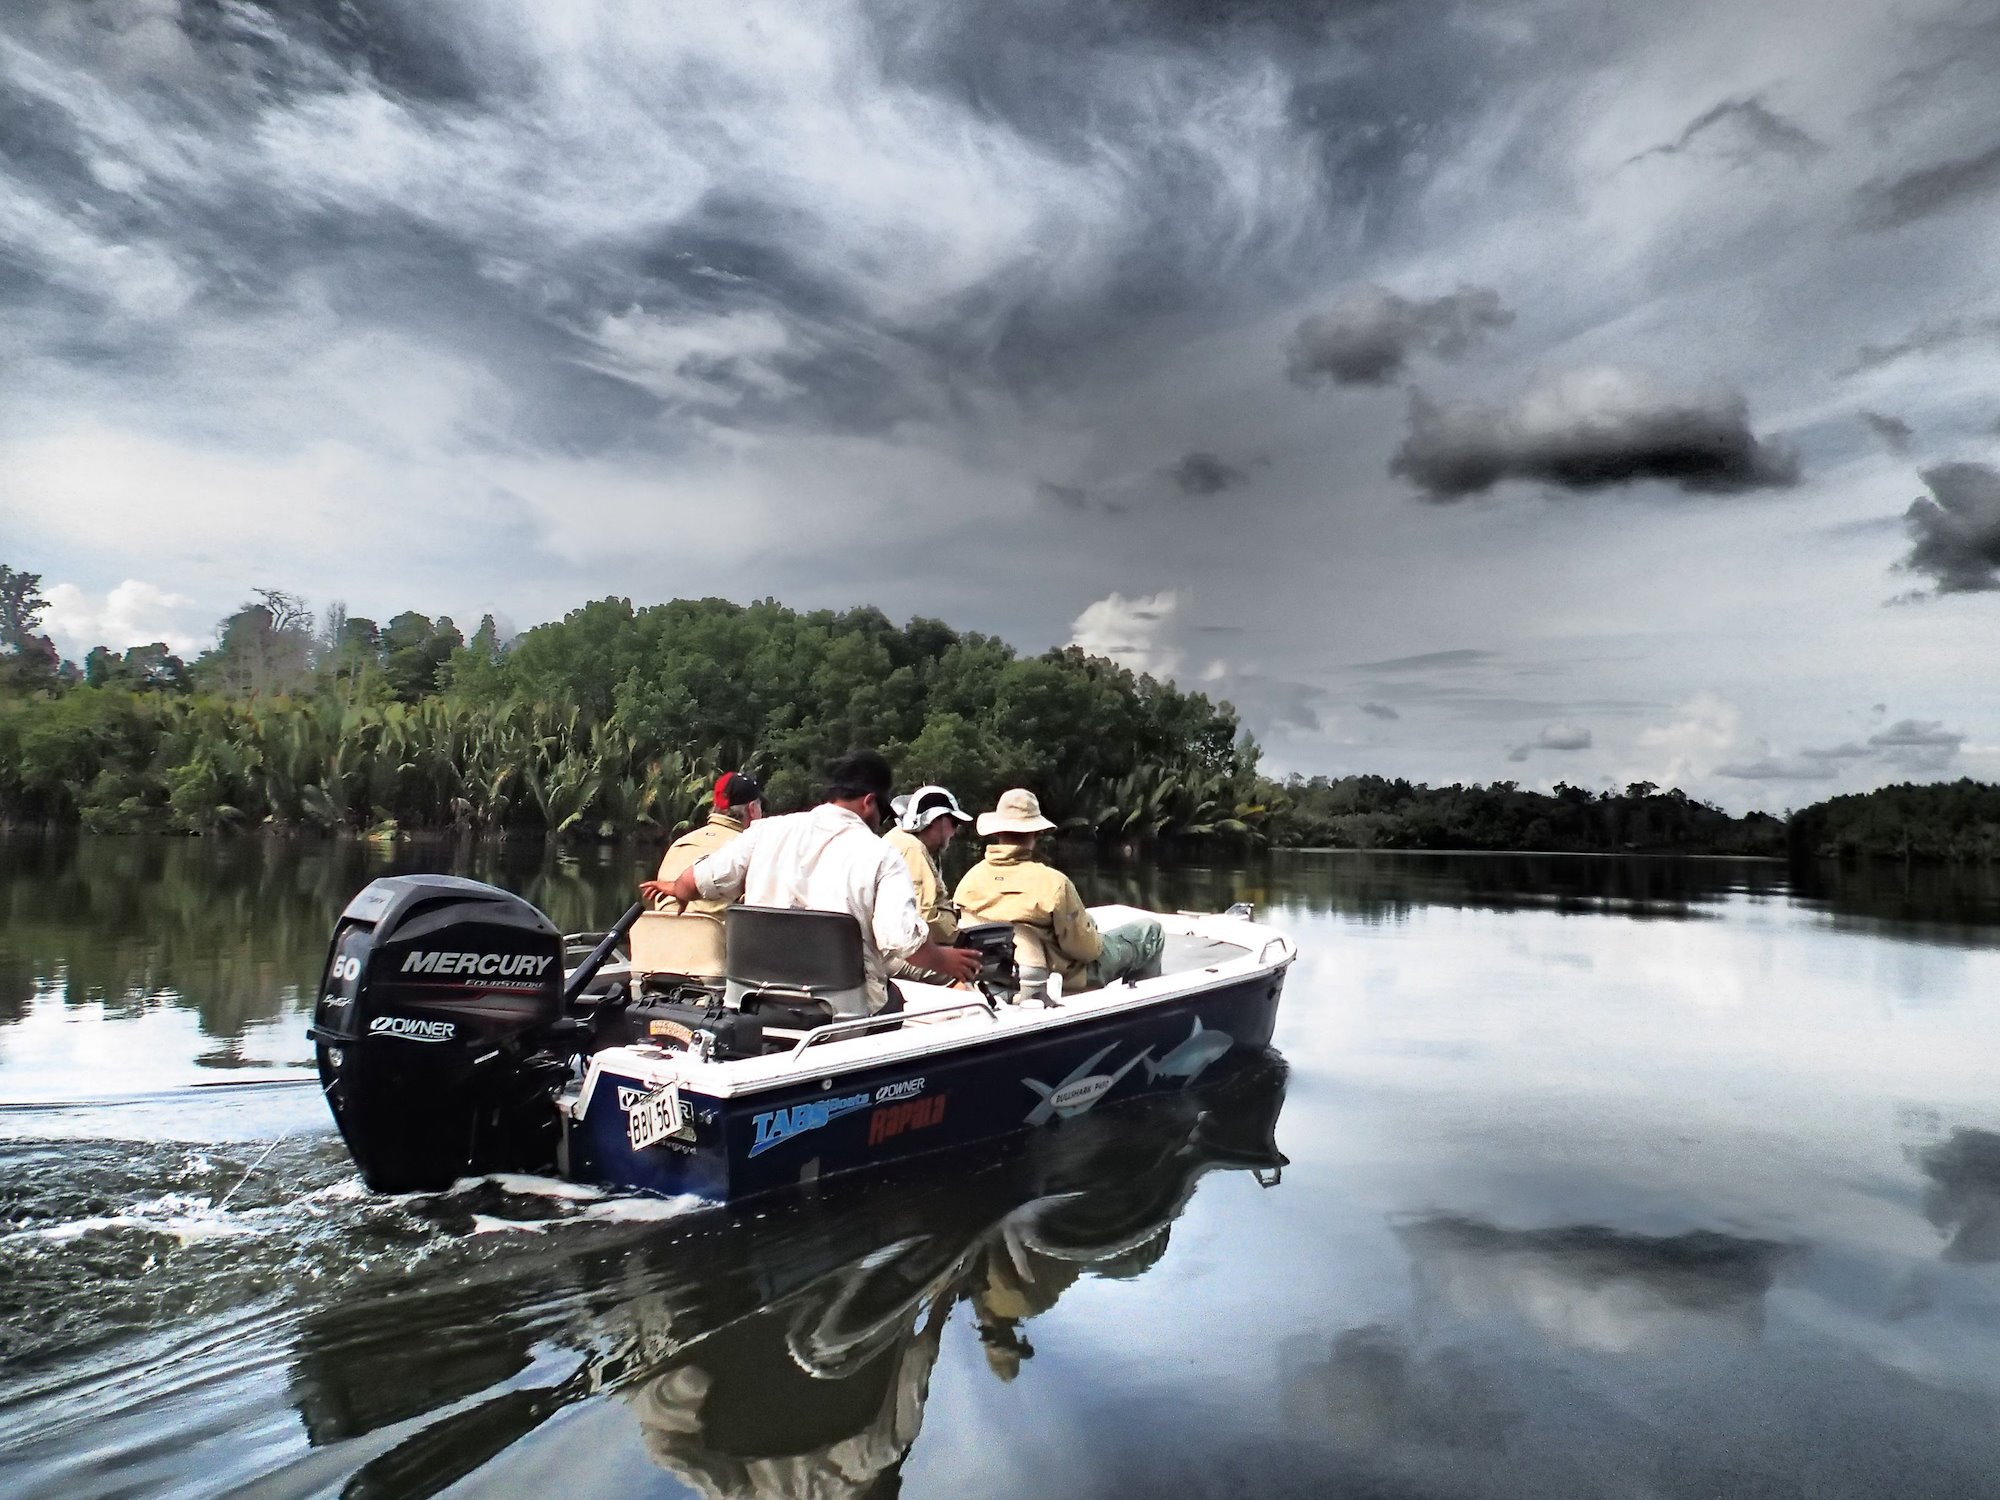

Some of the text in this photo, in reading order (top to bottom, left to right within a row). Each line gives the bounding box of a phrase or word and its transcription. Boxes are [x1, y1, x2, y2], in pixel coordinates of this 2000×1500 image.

[333, 955, 361, 981] 60
[401, 951, 553, 976] MERCURY
[391, 1018, 456, 1037] OWNER
[887, 1077, 925, 1097] OWNER
[752, 1100, 830, 1144] TABS
